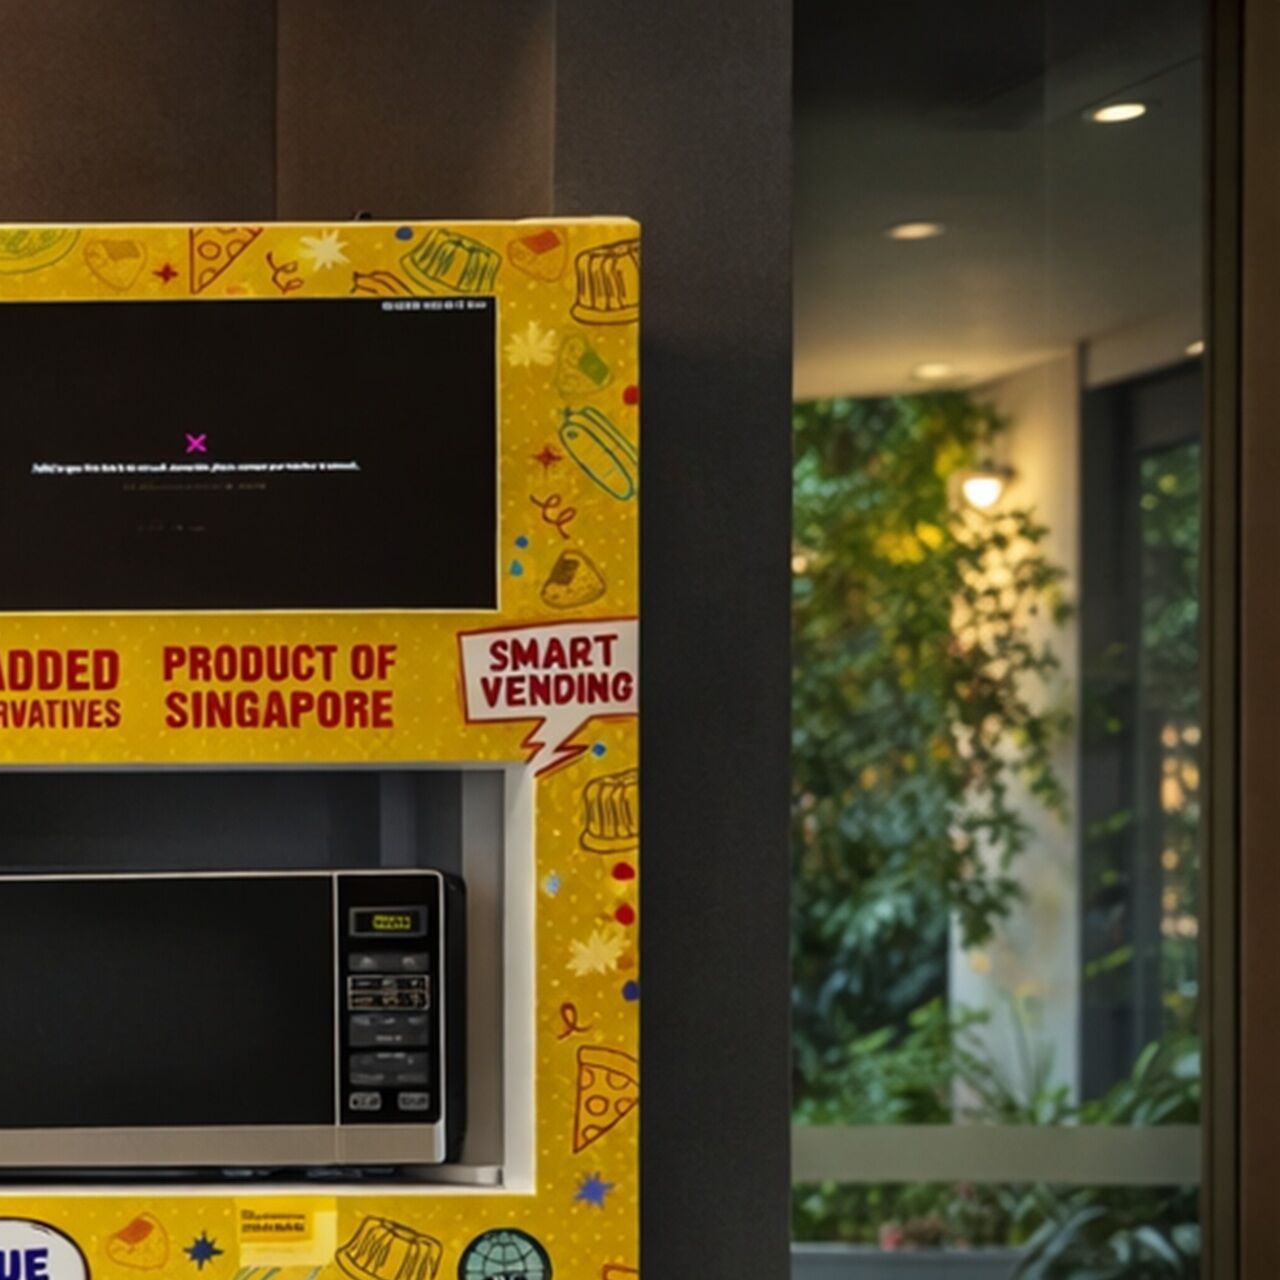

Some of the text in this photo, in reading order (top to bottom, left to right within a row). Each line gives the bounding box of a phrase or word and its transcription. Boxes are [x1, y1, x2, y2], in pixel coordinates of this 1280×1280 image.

[163, 644, 397, 683] PRODUCT OF
[489, 634, 619, 672] SMART
[165, 690, 395, 729] SINGAPORE
[480, 672, 634, 709] VENDING
